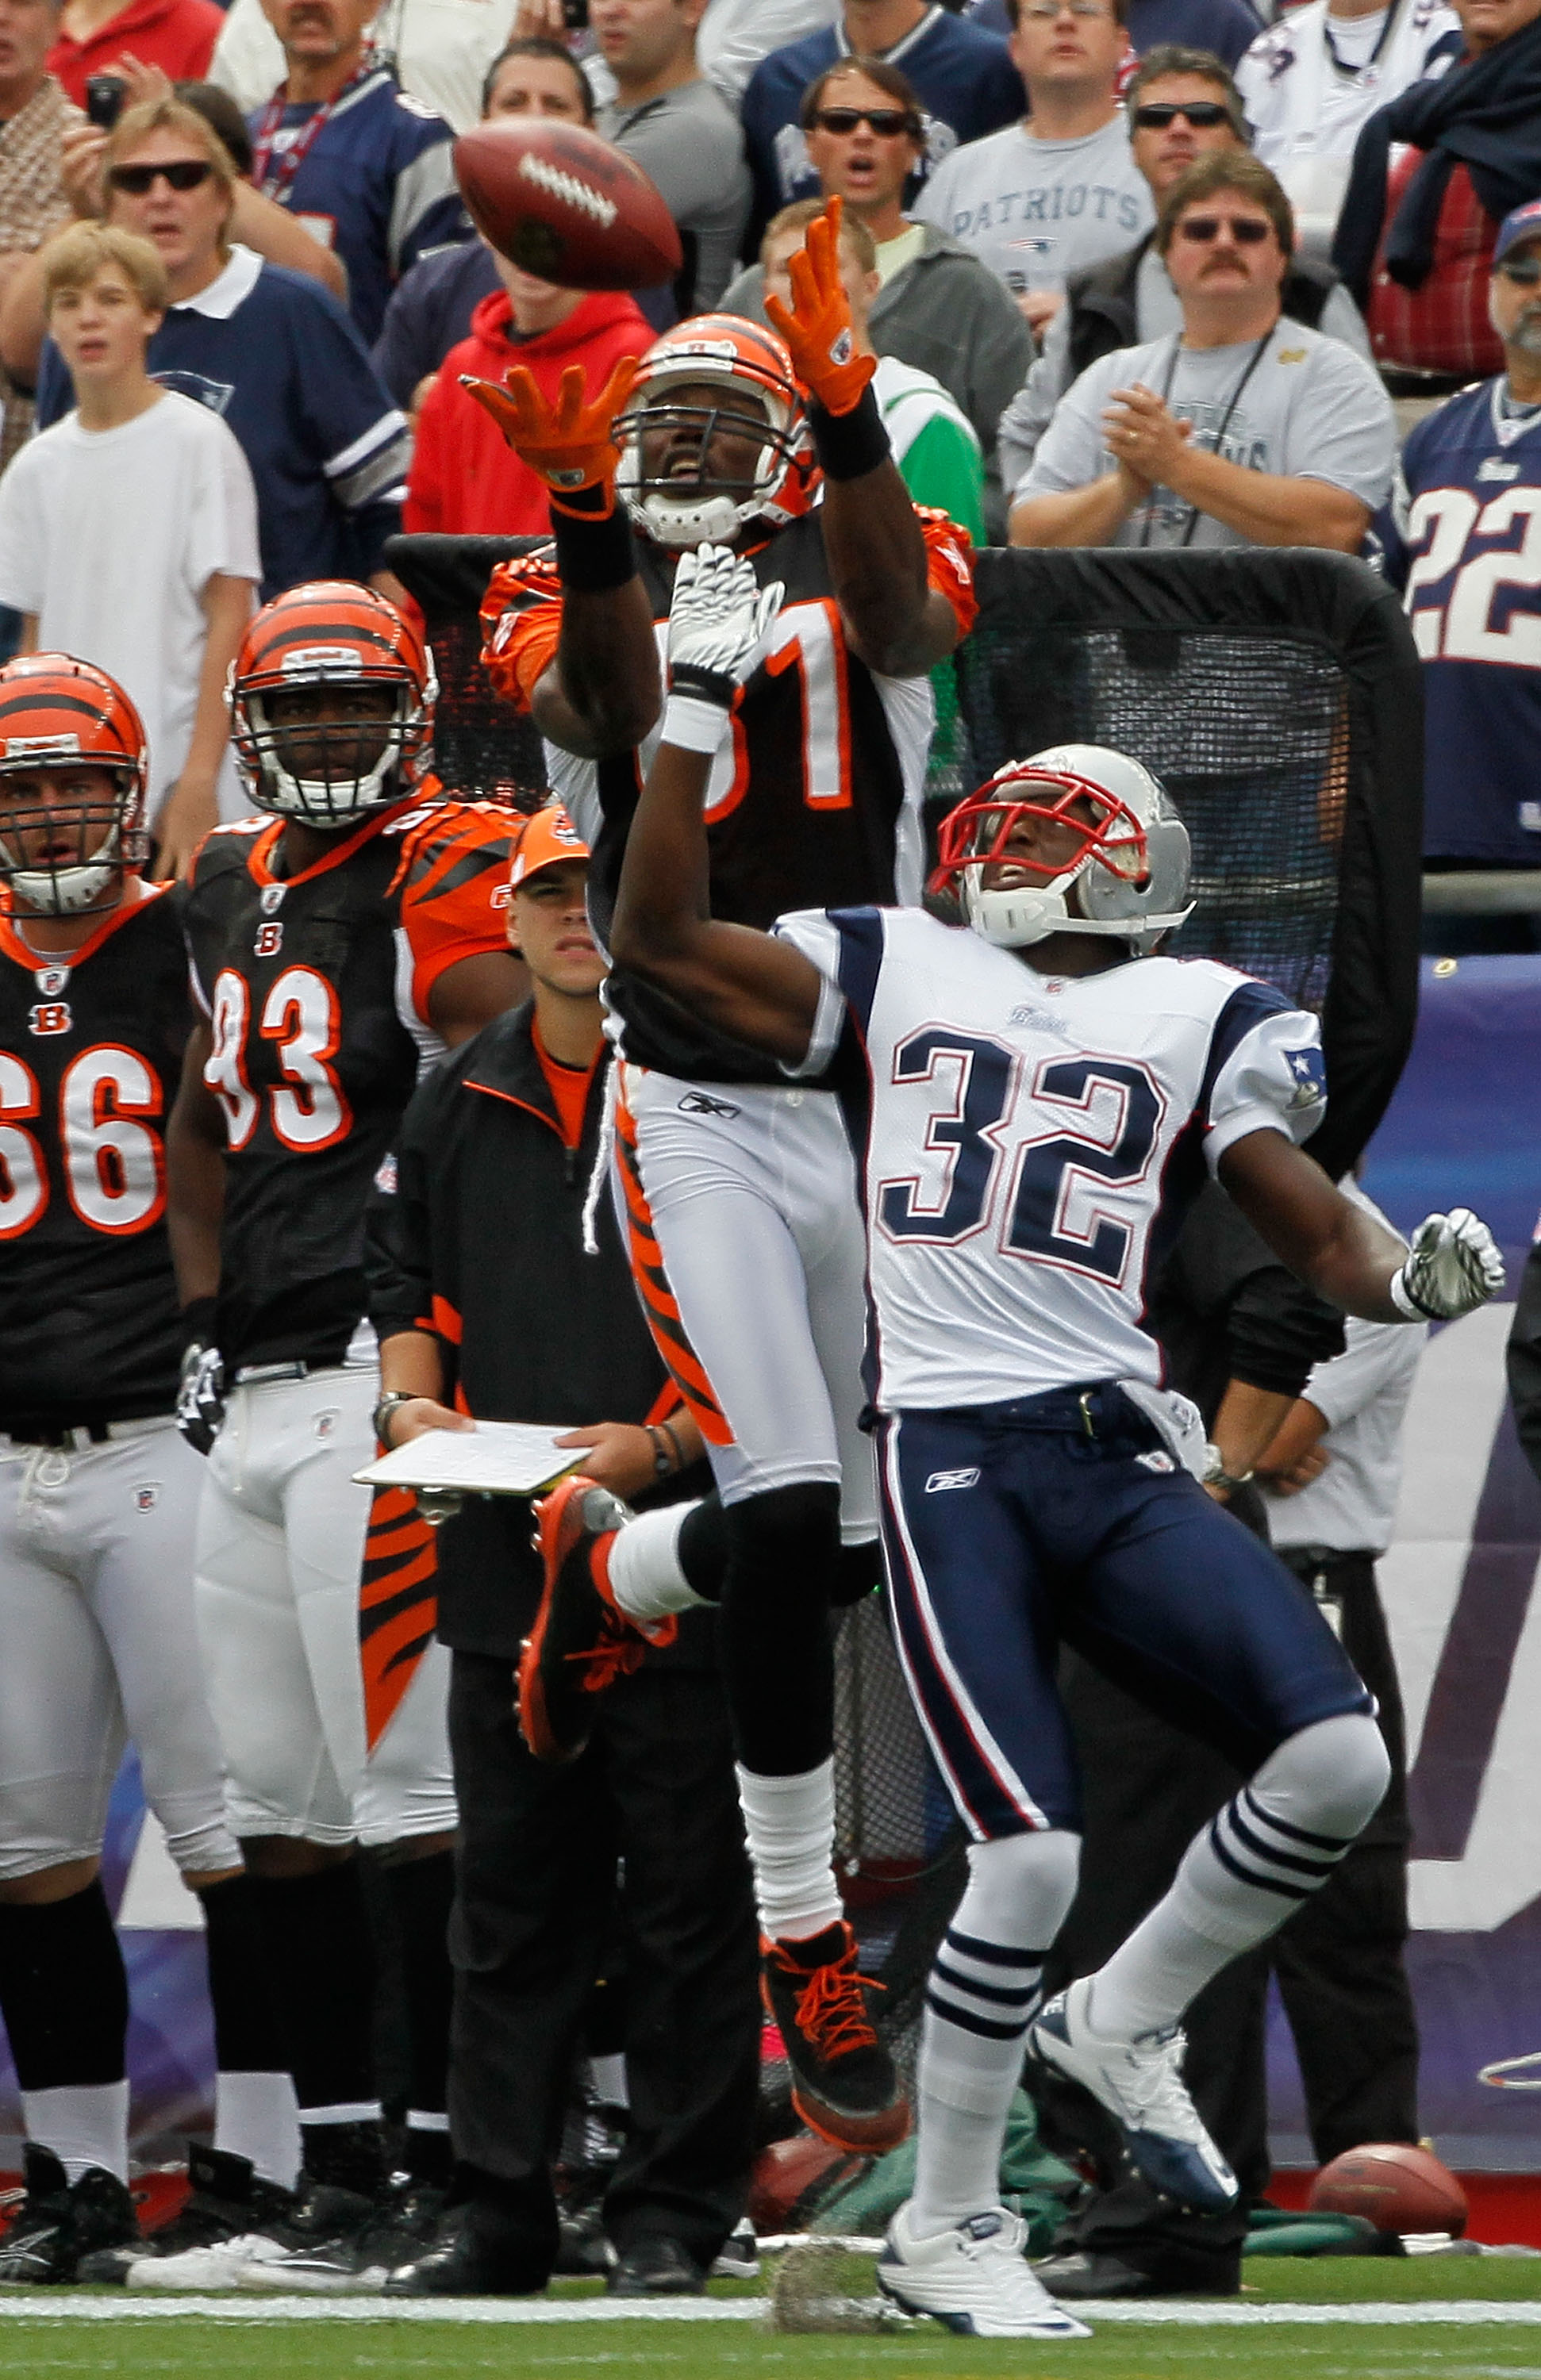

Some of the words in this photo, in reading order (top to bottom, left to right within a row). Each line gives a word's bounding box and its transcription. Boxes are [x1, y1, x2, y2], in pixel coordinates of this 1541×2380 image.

[952, 183, 1139, 236] PATRIOTS
[1402, 486, 1541, 670] 22
[203, 964, 354, 1153] 93
[876, 1021, 1167, 1290] 32
